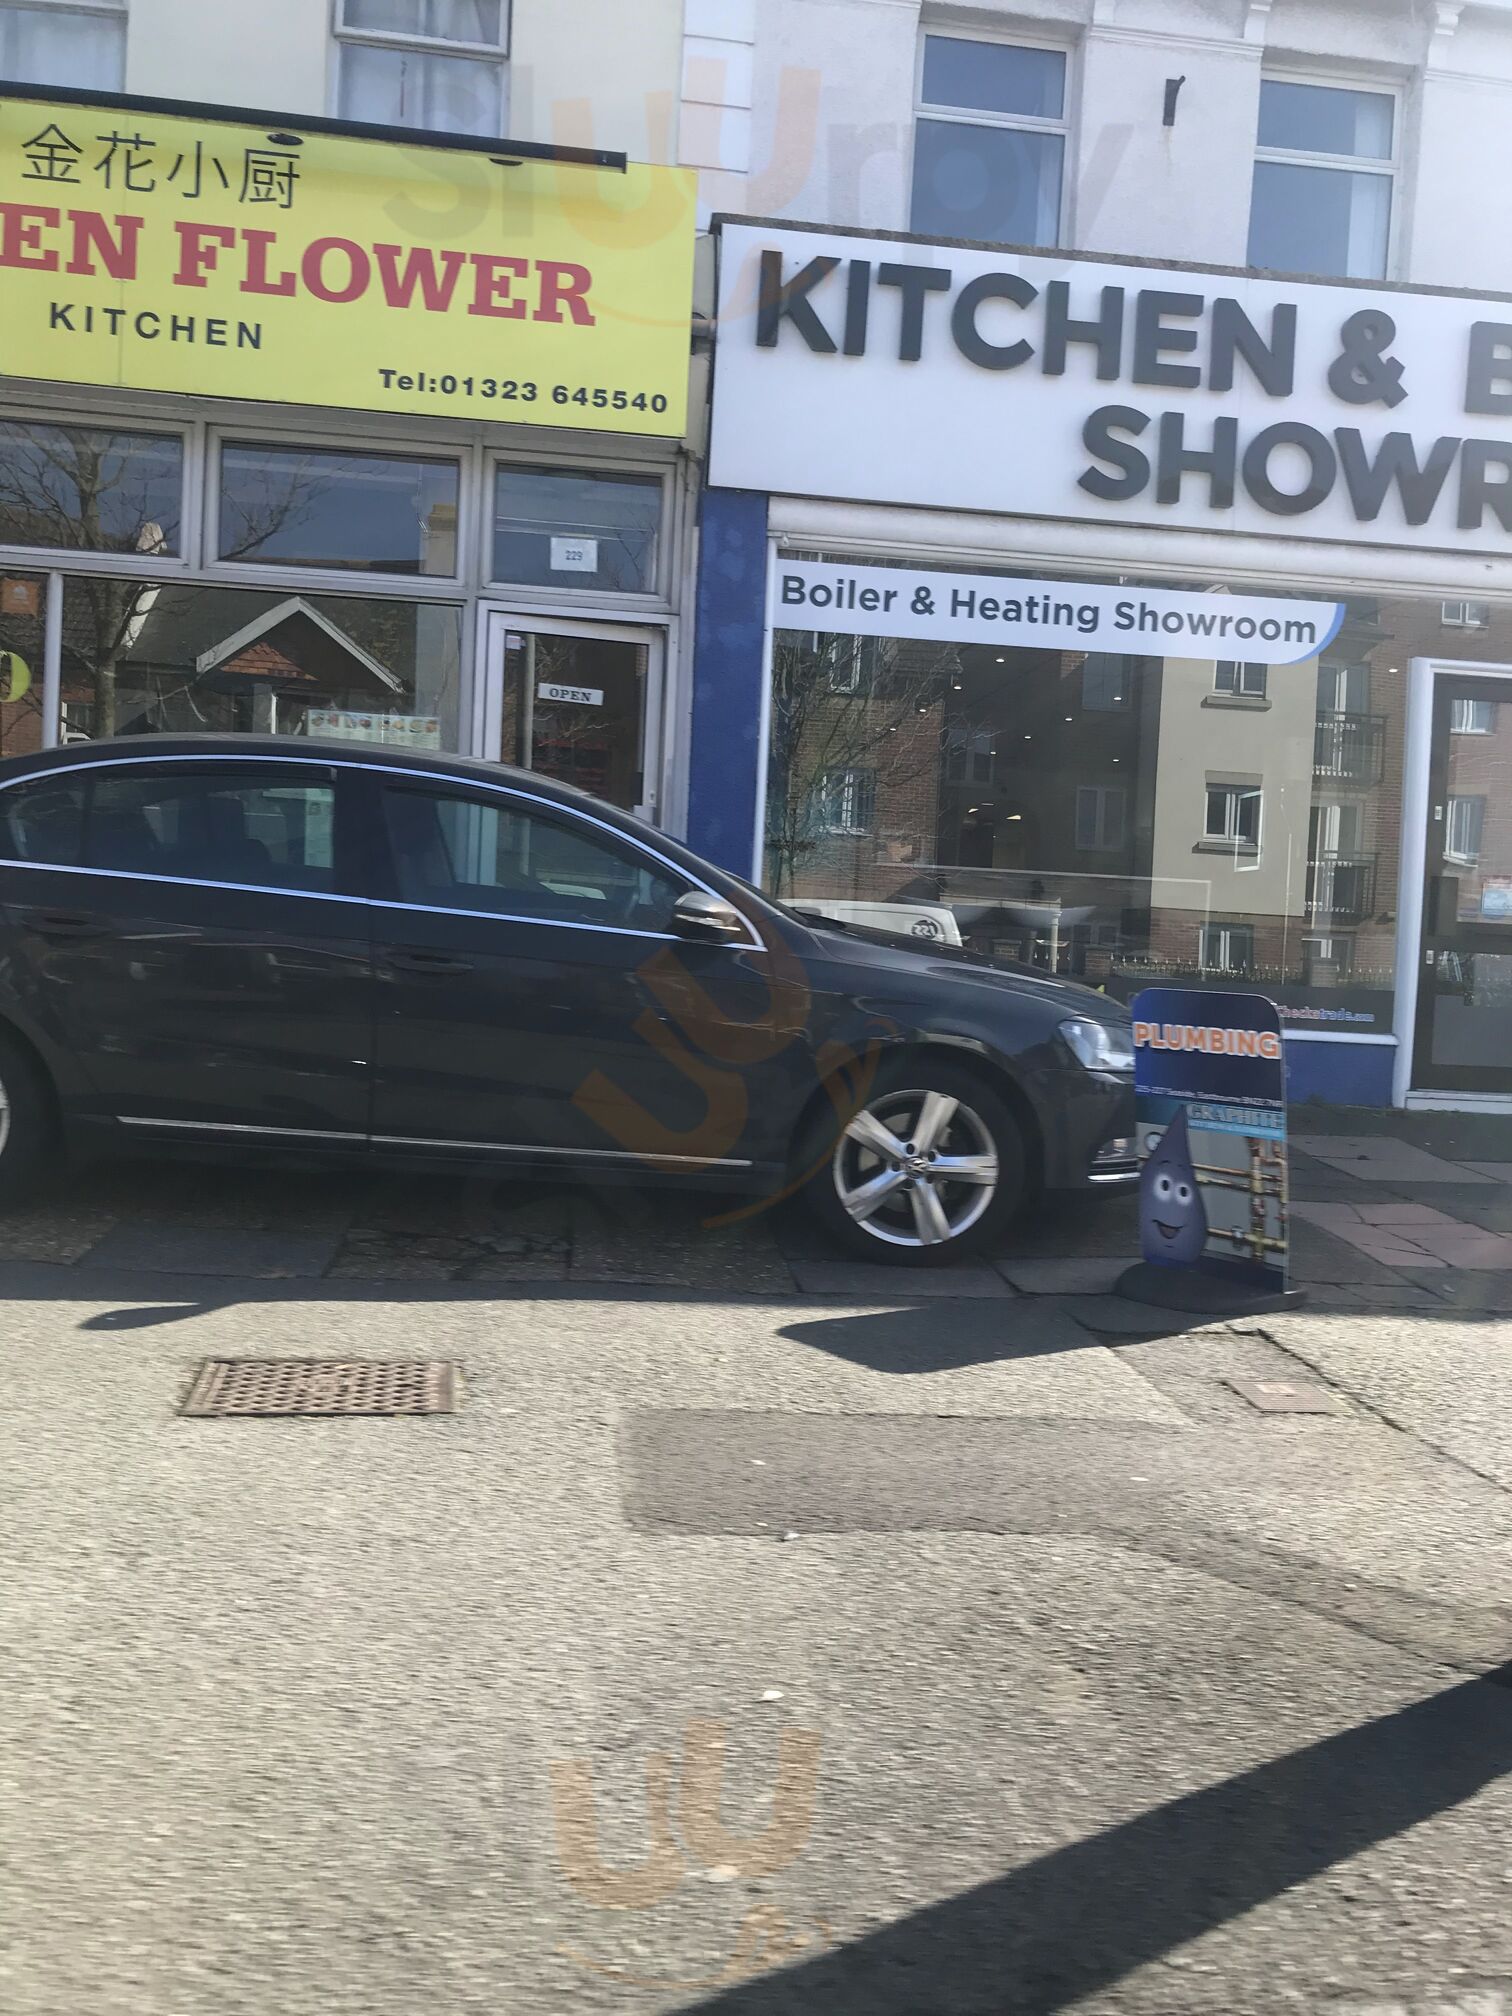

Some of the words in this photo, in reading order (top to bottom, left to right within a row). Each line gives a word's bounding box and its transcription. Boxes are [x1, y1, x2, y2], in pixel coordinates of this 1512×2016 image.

[21, 122, 301, 209] 金花小厨
[0, 202, 145, 280] EN
[173, 221, 596, 326] FLOWER
[50, 302, 264, 350] KITCHEN
[755, 249, 1299, 398] KITCHEN
[1328, 308, 1409, 409] &
[378, 367, 538, 402] Tel:01323
[552, 384, 668, 414] 645540
[1077, 404, 1512, 532] SHOWR
[564, 550, 584, 561] 229
[781, 575, 898, 614] Boiler
[909, 587, 936, 616] &
[951, 589, 1099, 634] Heating
[1113, 601, 1317, 645] Showroom
[549, 687, 592, 702] OPEN
[1133, 1021, 1281, 1060] PLUMBING
